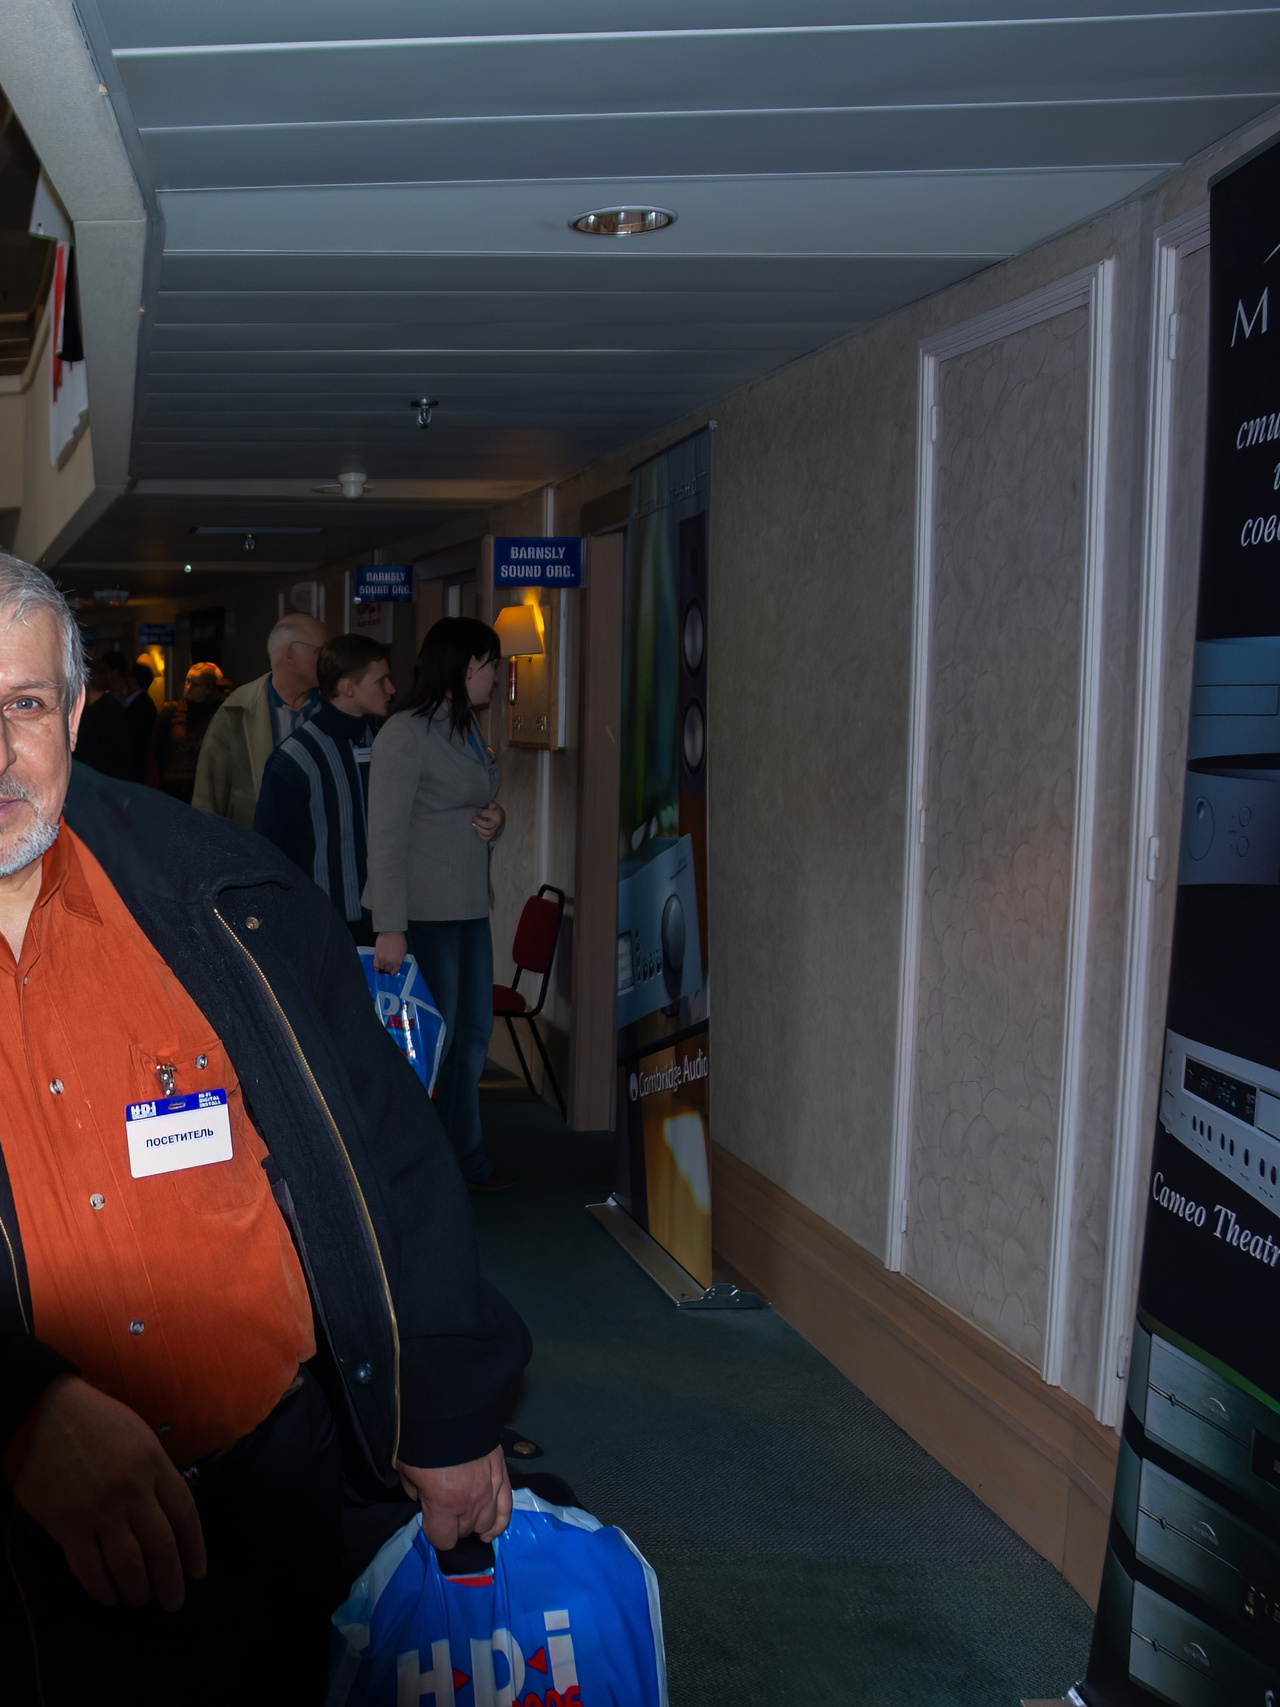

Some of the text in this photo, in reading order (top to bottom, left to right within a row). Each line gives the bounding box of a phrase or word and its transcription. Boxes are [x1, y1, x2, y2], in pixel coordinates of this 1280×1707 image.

[510, 546, 565, 560] BARNSLY
[500, 564, 575, 578] SOUND ORG.
[639, 1048, 709, 1097] Cambridge Audio
[146, 1128, 214, 1148] ПОСЕТИТЕЛЬ
[1152, 1171, 1207, 1228] Cameo
